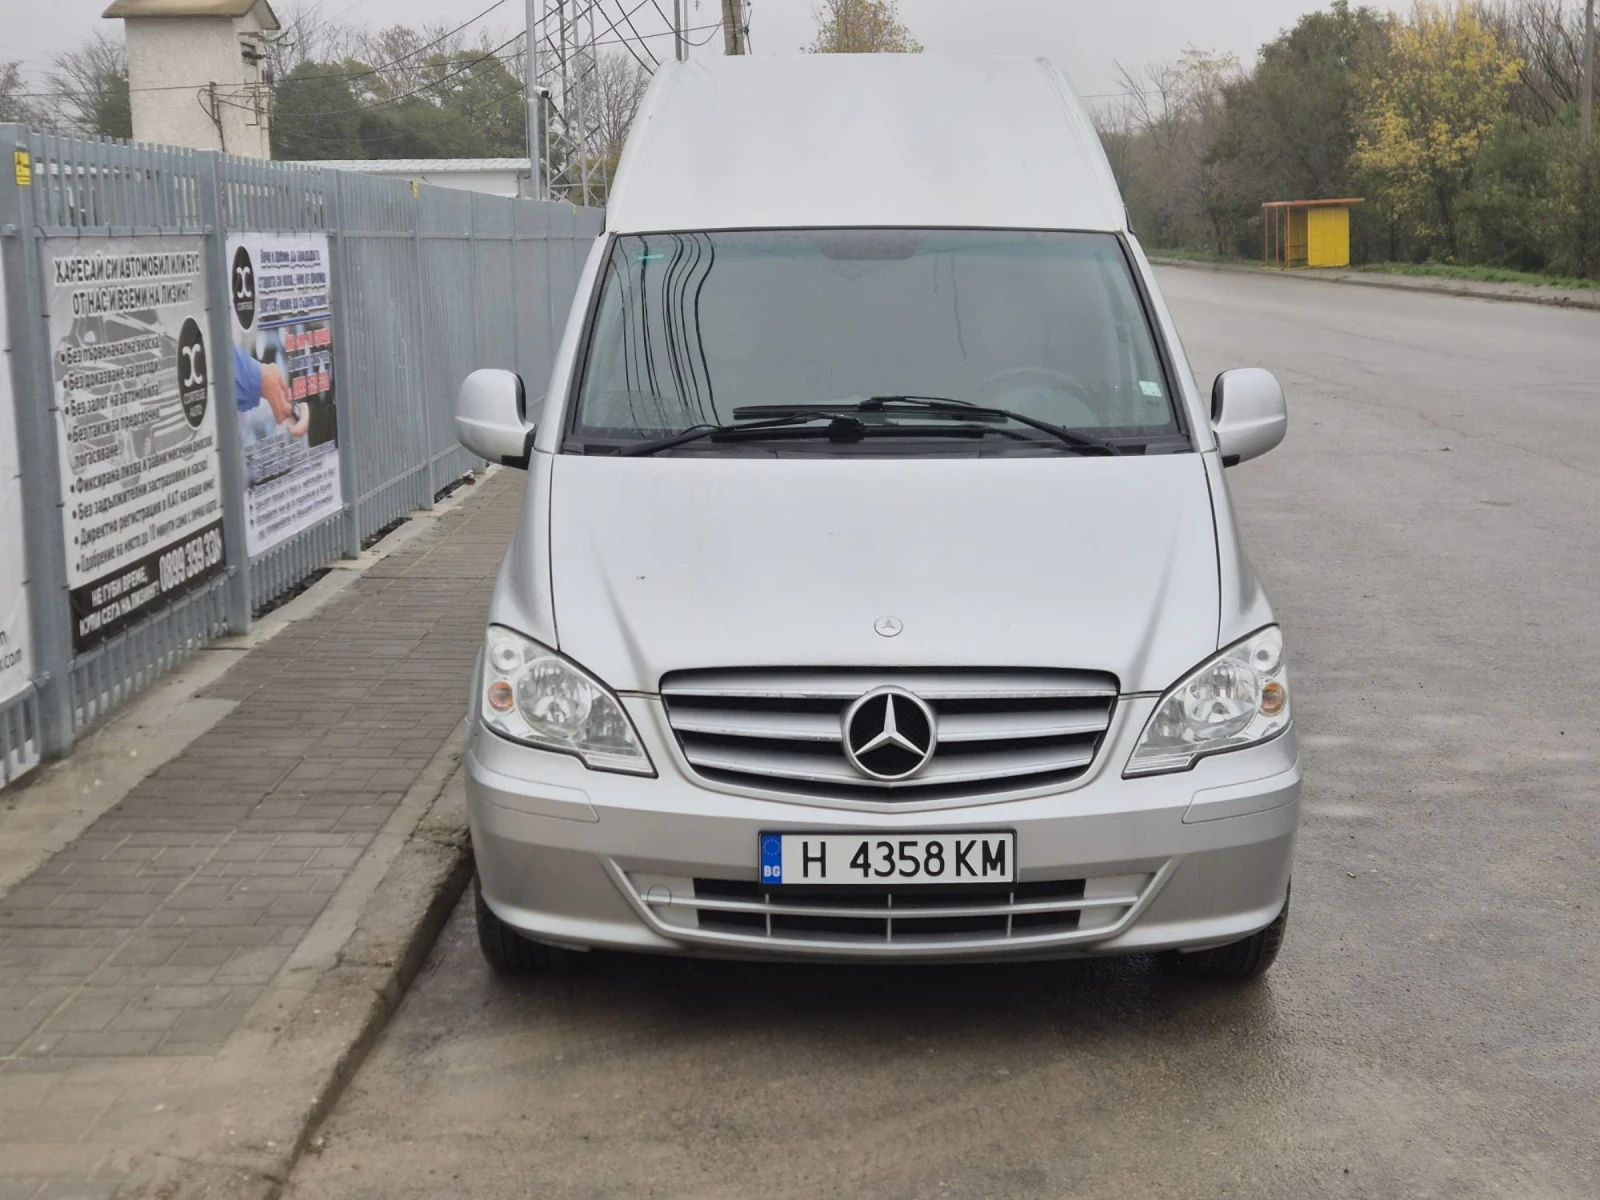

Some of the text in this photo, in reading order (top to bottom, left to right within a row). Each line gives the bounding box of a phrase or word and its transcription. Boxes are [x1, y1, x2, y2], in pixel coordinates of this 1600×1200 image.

[54, 253, 199, 282] ХАРЕСАЙ СИ АВТОМОБИЛ ИЛИ БУС
[72, 283, 193, 313] ОТ НАС И ВЗЕМИ НА ЛИЗИНГ!
[66, 347, 81, 363] Без
[83, 341, 135, 362] първоначална
[69, 373, 83, 389] Без
[85, 369, 124, 388] доказване
[126, 366, 134, 378] на
[71, 400, 84, 416] Без
[86, 396, 107, 412] залог
[109, 394, 118, 406] на
[72, 426, 86, 442] Без
[88, 421, 110, 438] такси
[111, 419, 119, 431] за
[76, 469, 120, 493] Фиксирана
[120, 461, 140, 478] лихва
[78, 503, 92, 519] Без
[94, 485, 146, 514] задължителни
[79, 520, 117, 546] Директно
[166, 490, 178, 507] КАТ
[91, 586, 102, 607] НЕ
[763, 866, 781, 878] BG
[849, 840, 946, 878] 4358
